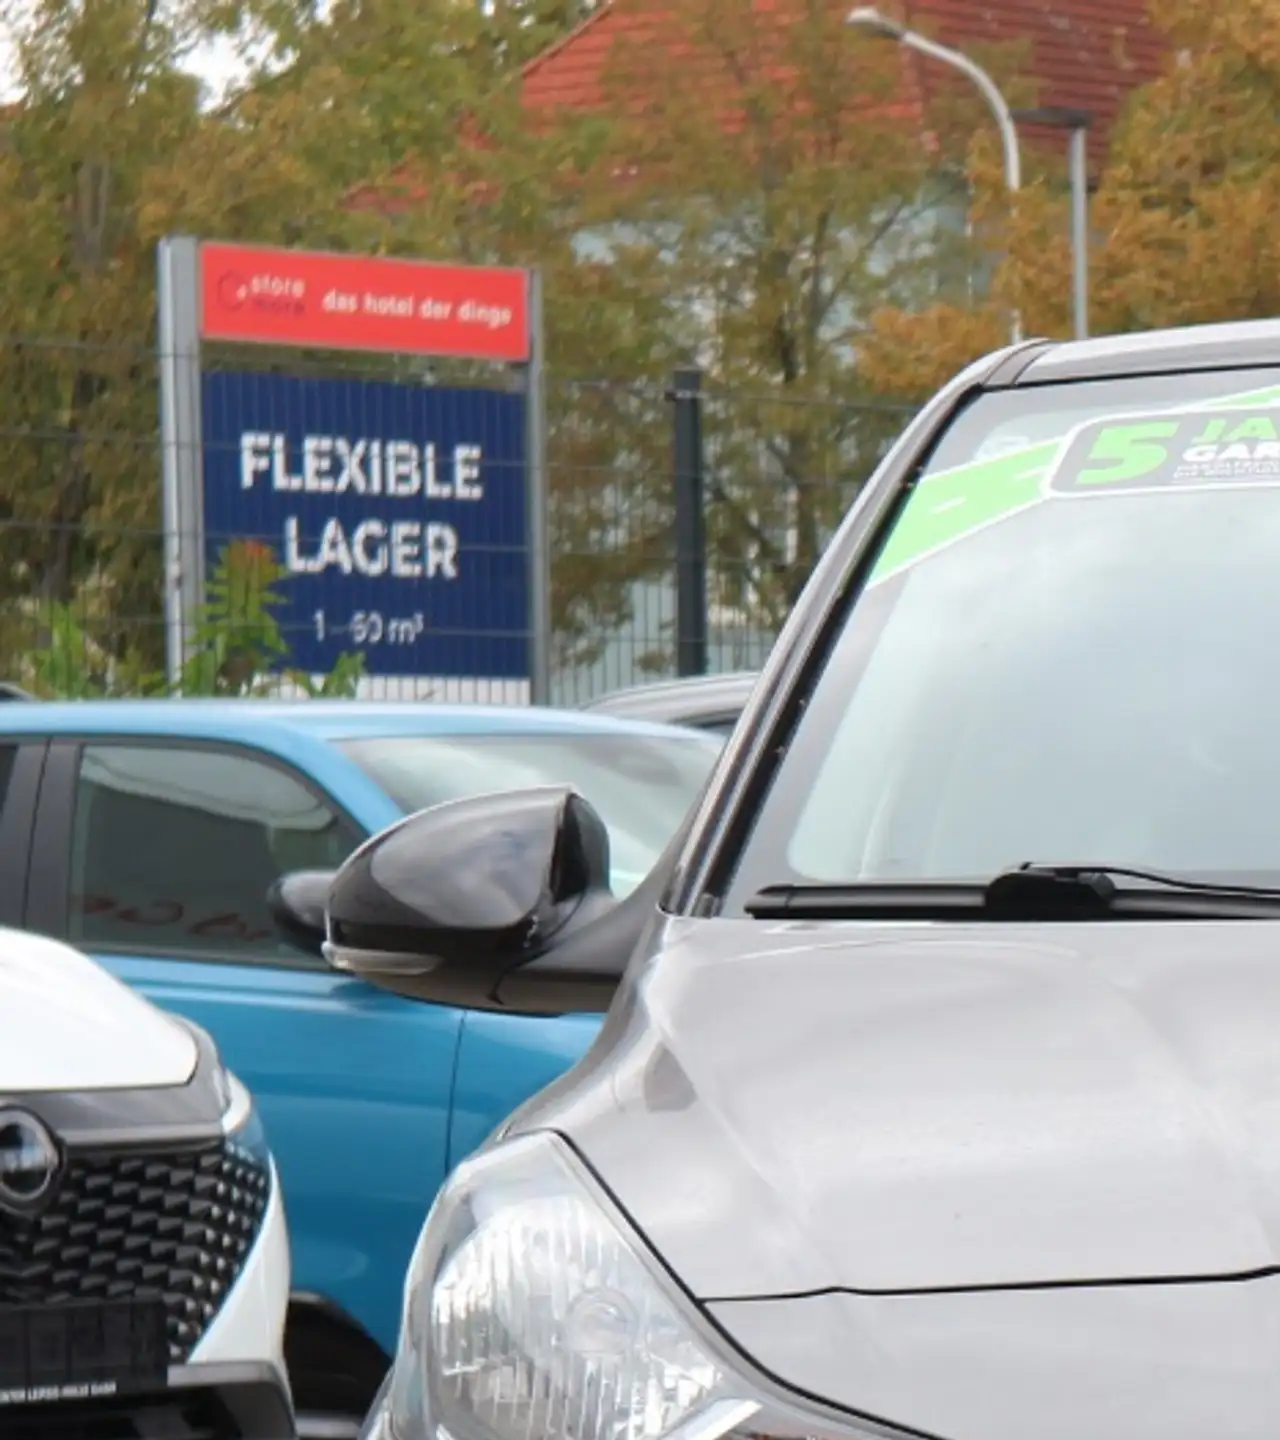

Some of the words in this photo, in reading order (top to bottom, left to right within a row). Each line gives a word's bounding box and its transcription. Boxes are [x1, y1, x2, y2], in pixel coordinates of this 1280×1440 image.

[240, 431, 484, 501] FLEXIBLE
[1075, 421, 1180, 485] 5
[285, 517, 458, 579] LAGER
